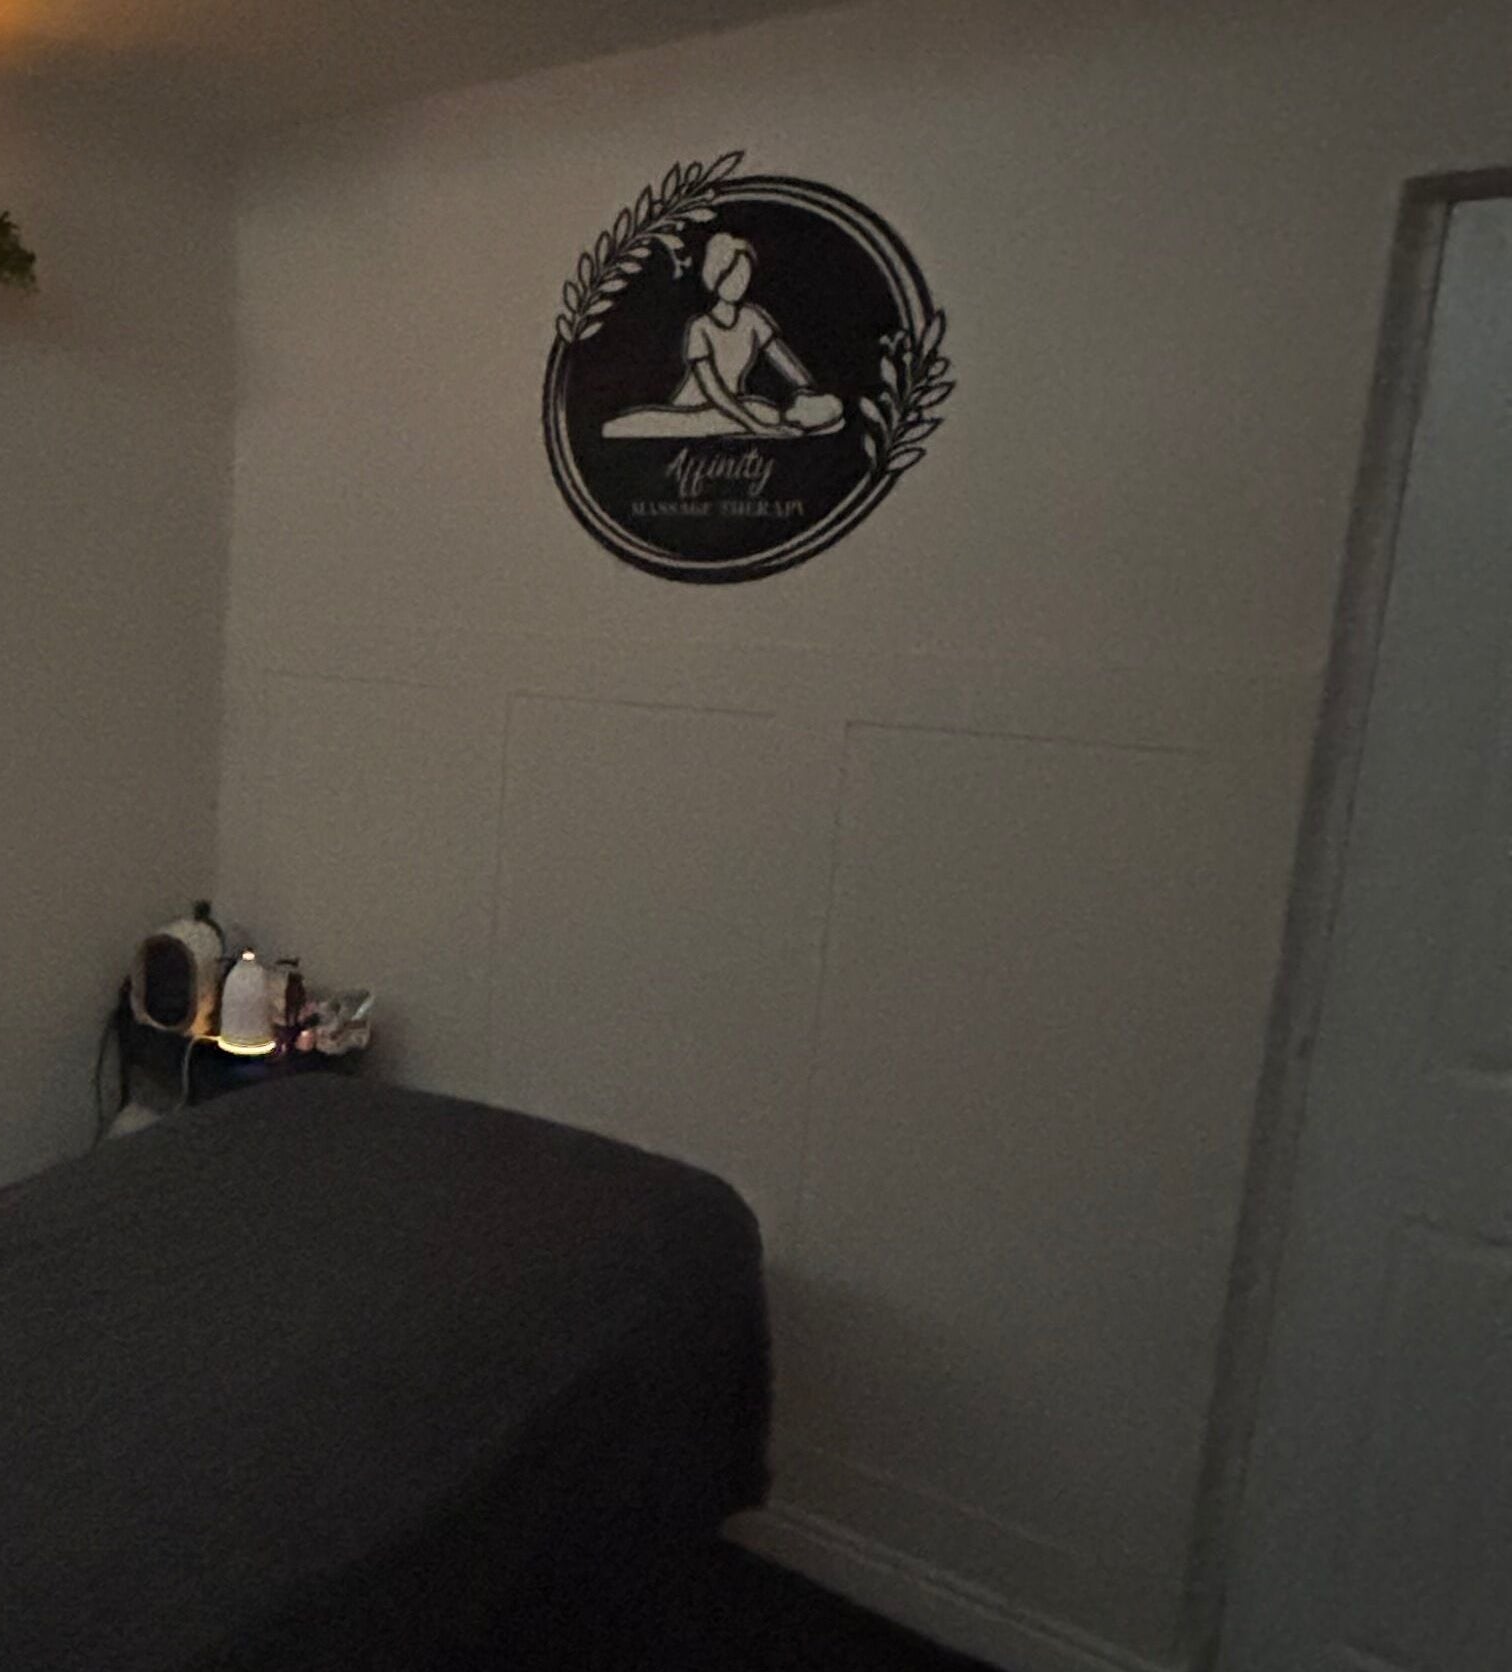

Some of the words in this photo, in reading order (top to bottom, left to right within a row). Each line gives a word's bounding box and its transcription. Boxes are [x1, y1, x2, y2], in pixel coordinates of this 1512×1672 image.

[666, 448, 775, 498] Affinity
[631, 500, 710, 516] MASSAGE
[720, 500, 804, 517] THERAPY
